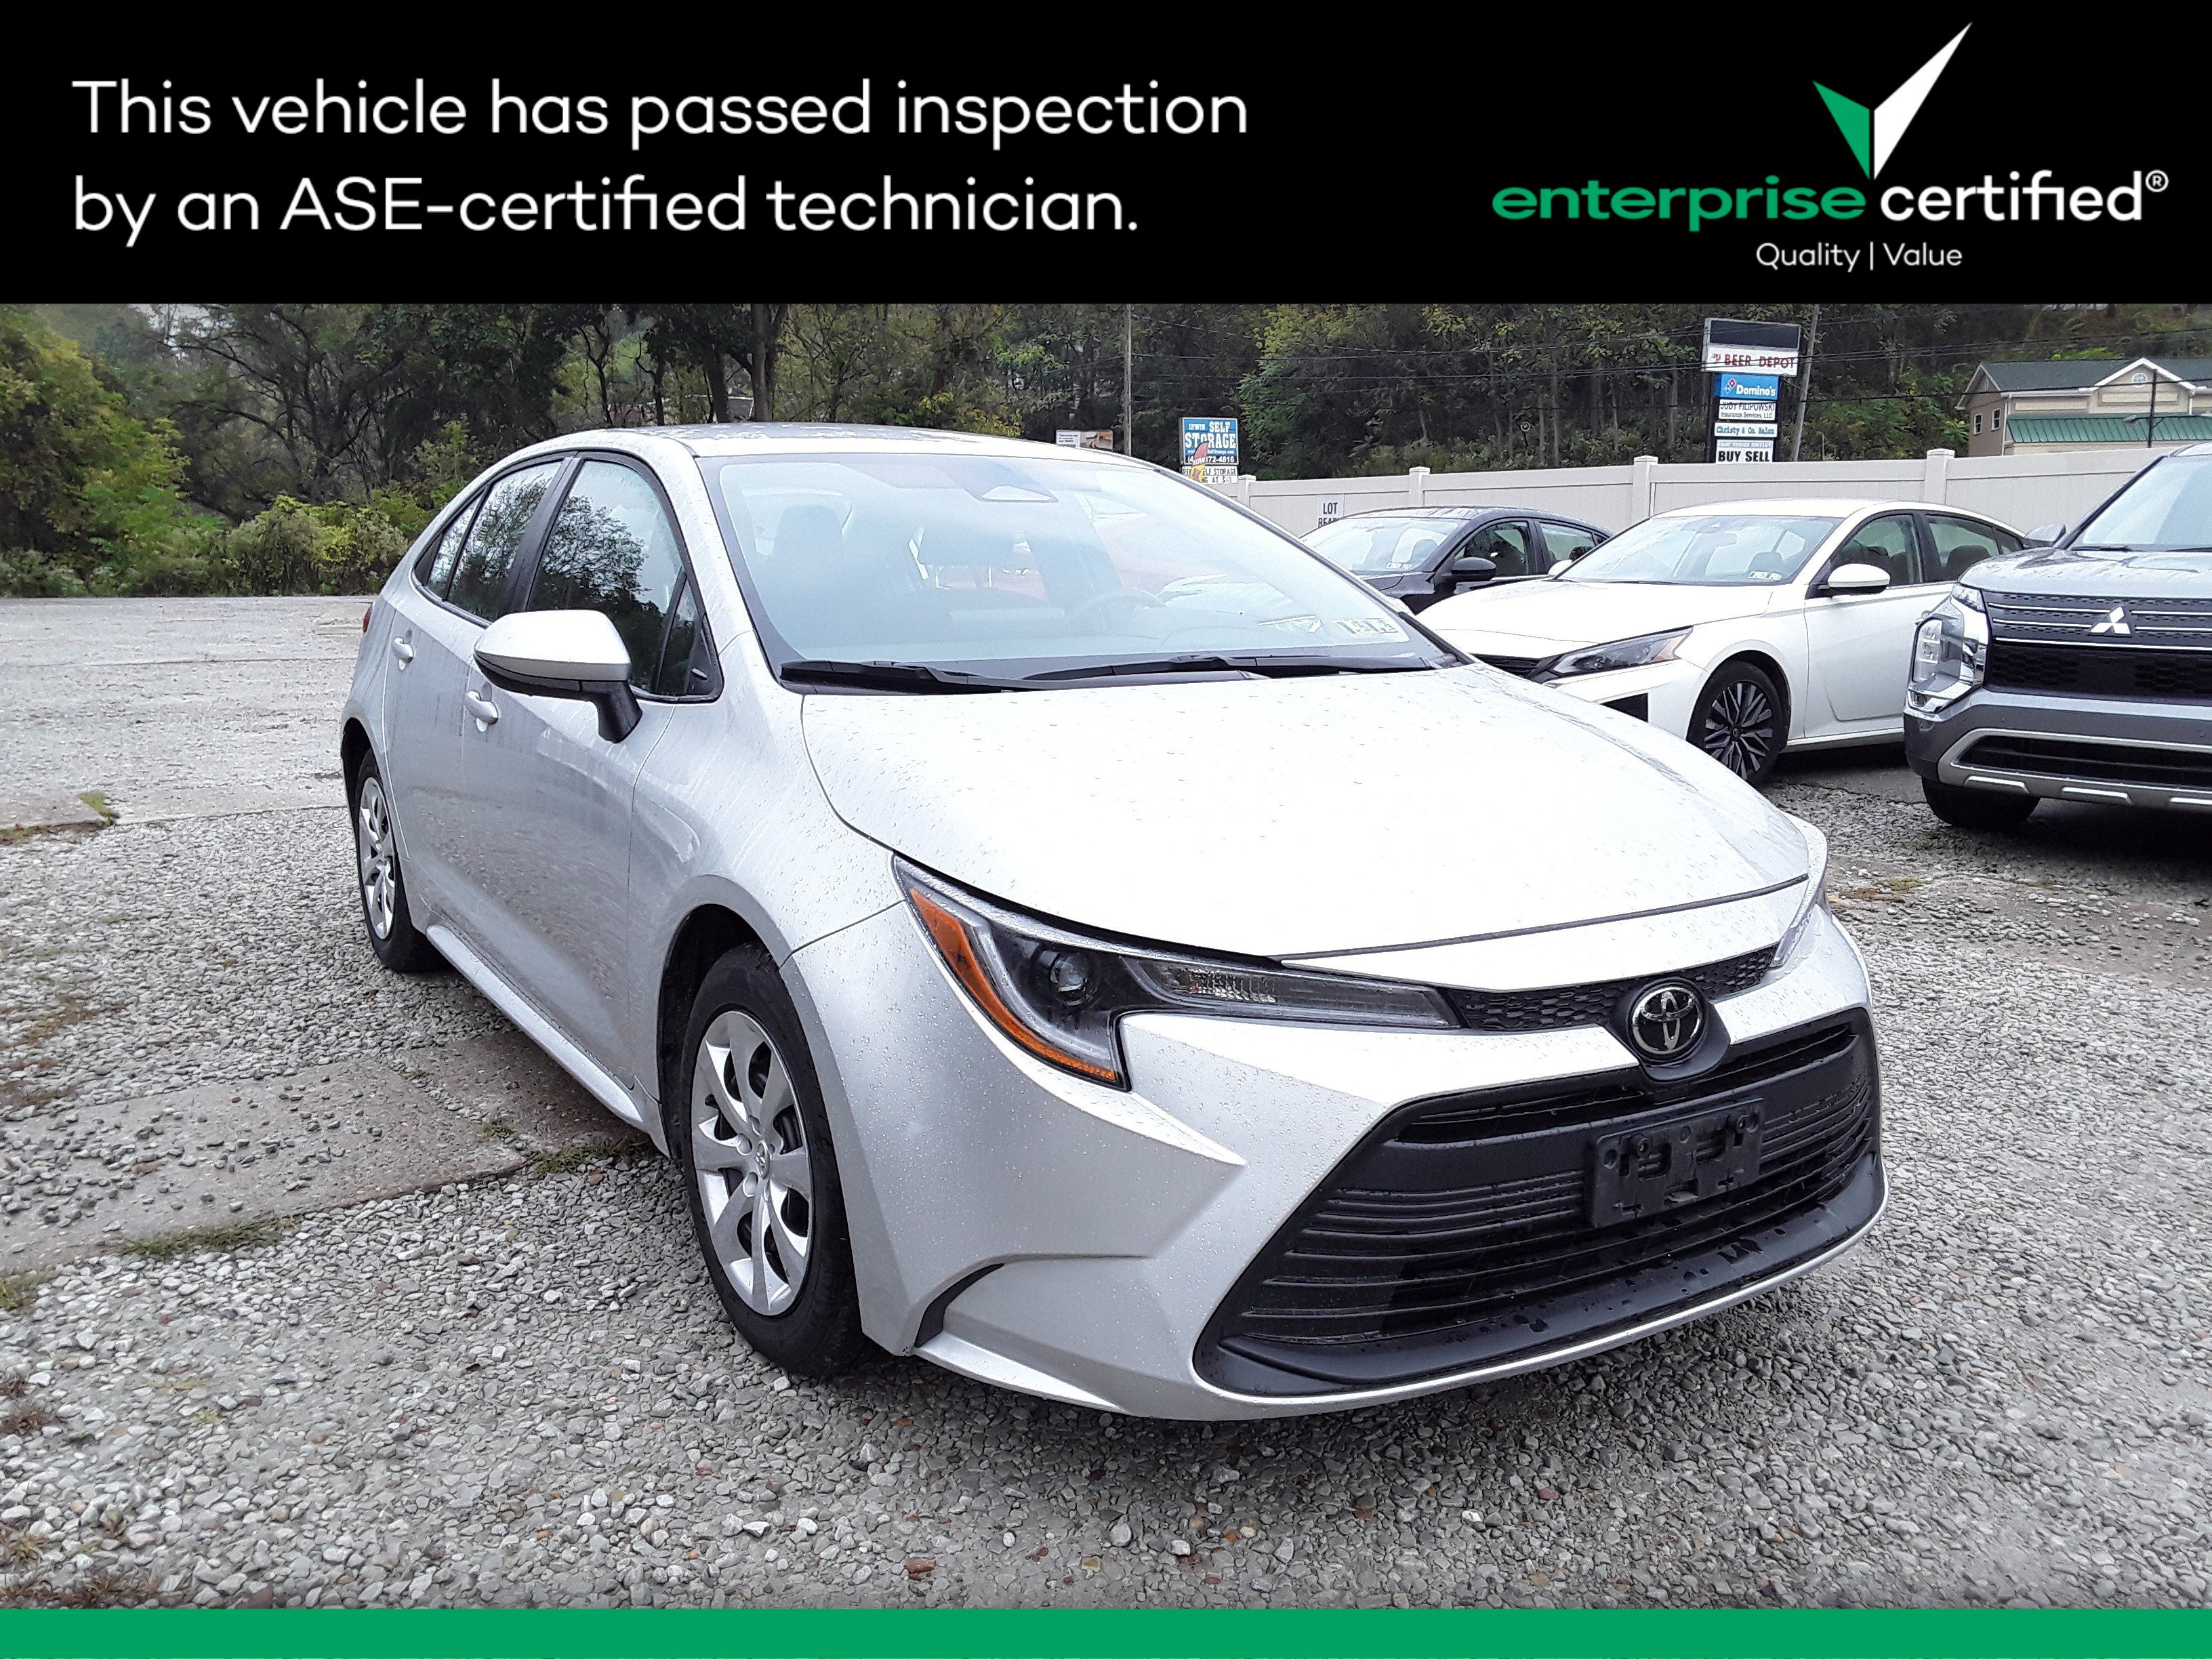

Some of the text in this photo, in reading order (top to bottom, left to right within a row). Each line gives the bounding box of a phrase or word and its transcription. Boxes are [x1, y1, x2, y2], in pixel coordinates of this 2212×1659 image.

[1725, 354, 1751, 367] BEER
[1759, 356, 1795, 369] DEPOT
[1736, 384, 1776, 396] Domino's
[1209, 421, 1231, 433] SELF
[1185, 432, 1236, 449] STORAGE
[1718, 451, 1769, 462] BUY SELL
[1323, 502, 1338, 514] LOT
